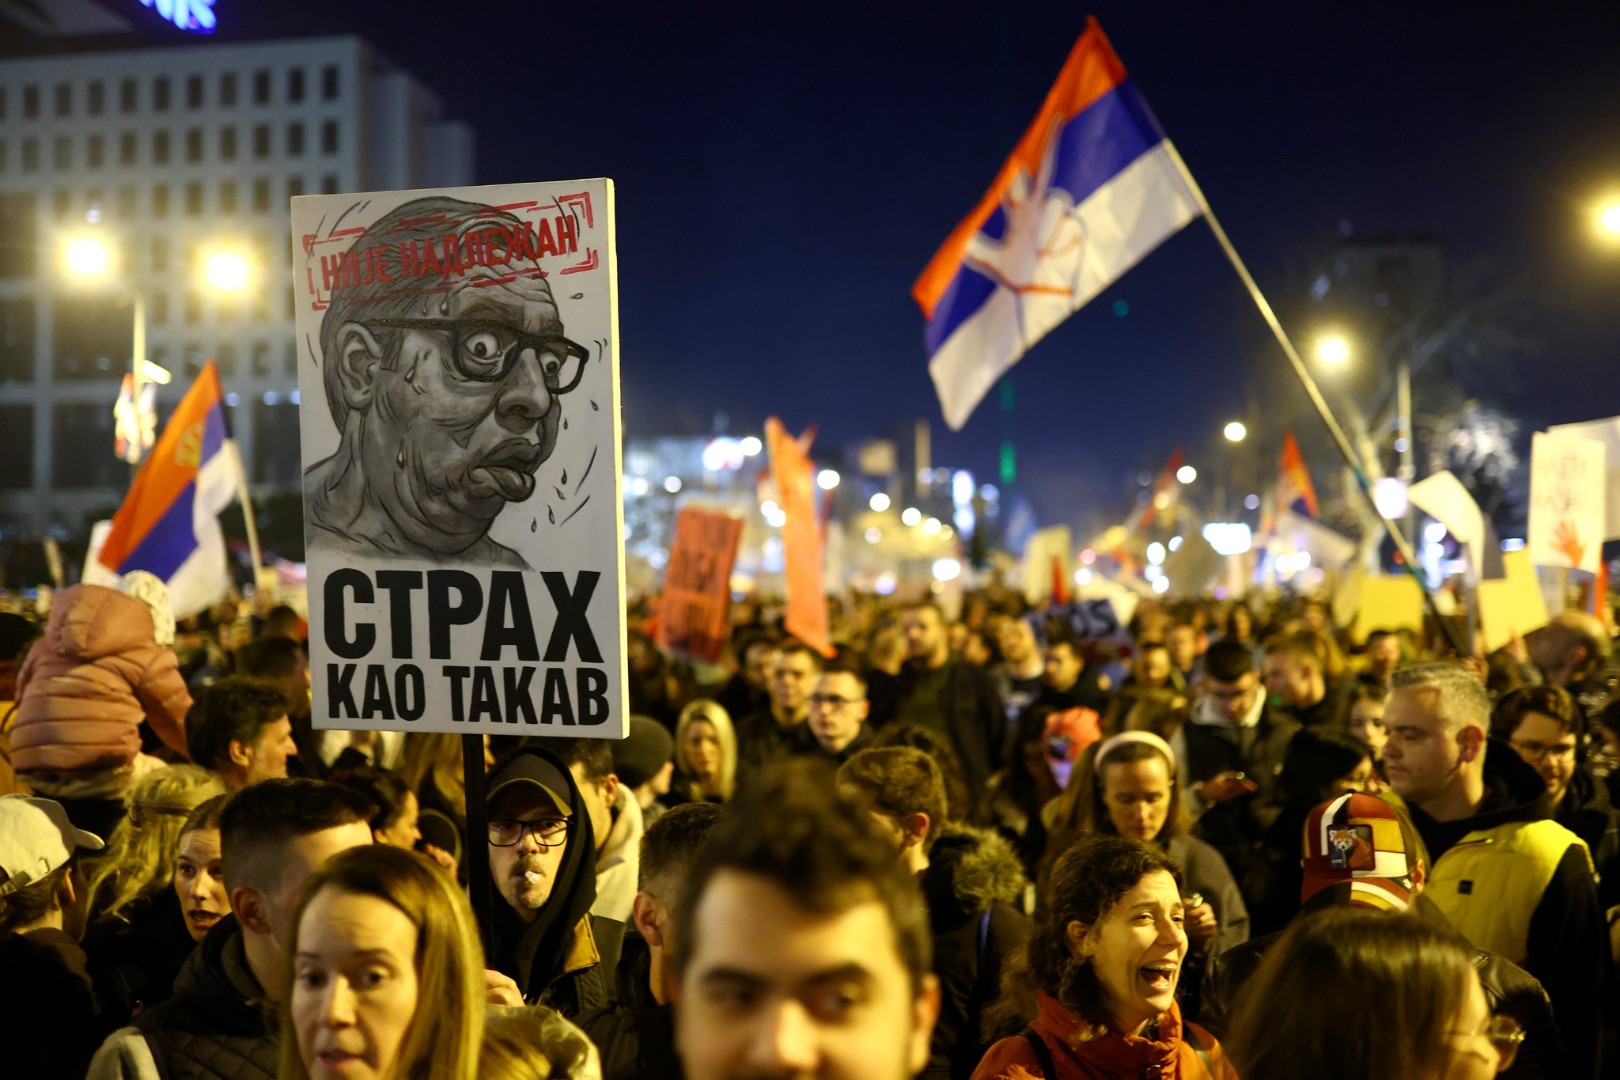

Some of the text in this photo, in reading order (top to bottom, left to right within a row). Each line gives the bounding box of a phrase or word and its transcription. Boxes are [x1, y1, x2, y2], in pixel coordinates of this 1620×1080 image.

[320, 214, 578, 291] НИЈЕ НАДЛЕЖАН
[324, 568, 604, 663] СТРАХ
[327, 663, 610, 726] КАО ТАКАВ
